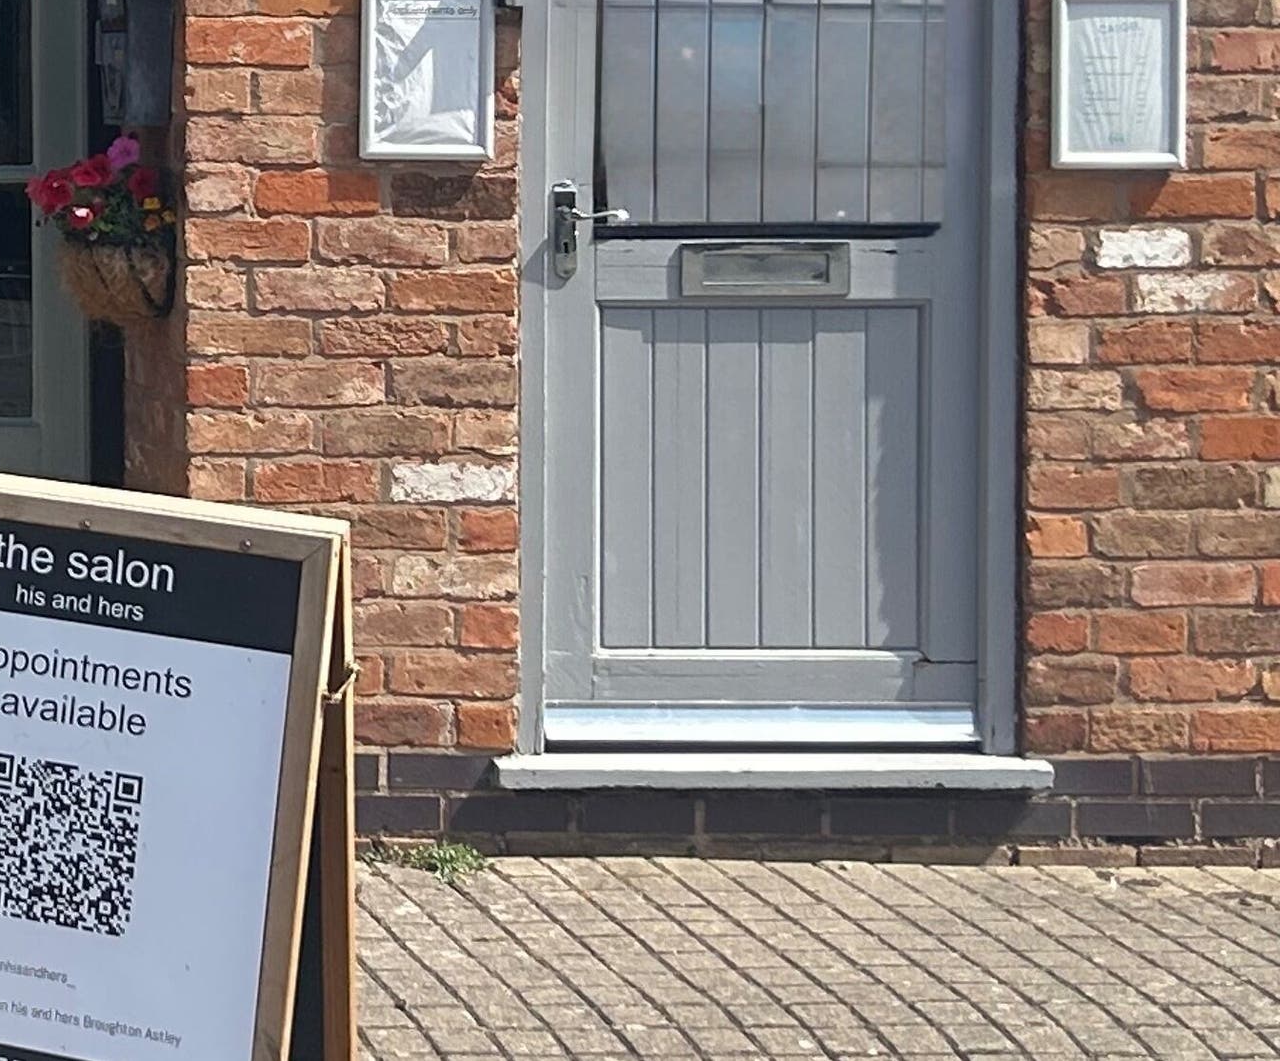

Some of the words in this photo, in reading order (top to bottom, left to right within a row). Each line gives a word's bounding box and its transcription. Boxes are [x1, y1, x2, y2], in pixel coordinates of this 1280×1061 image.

[66, 549, 175, 593] salon
[15, 582, 46, 607] his
[51, 592, 91, 613] and
[97, 595, 144, 622] hers
[0, 693, 146, 736] available
[10, 1000, 28, 1017] his
[31, 1005, 52, 1020] and
[54, 1008, 80, 1026] hers
[82, 1014, 142, 1037] Broughton
